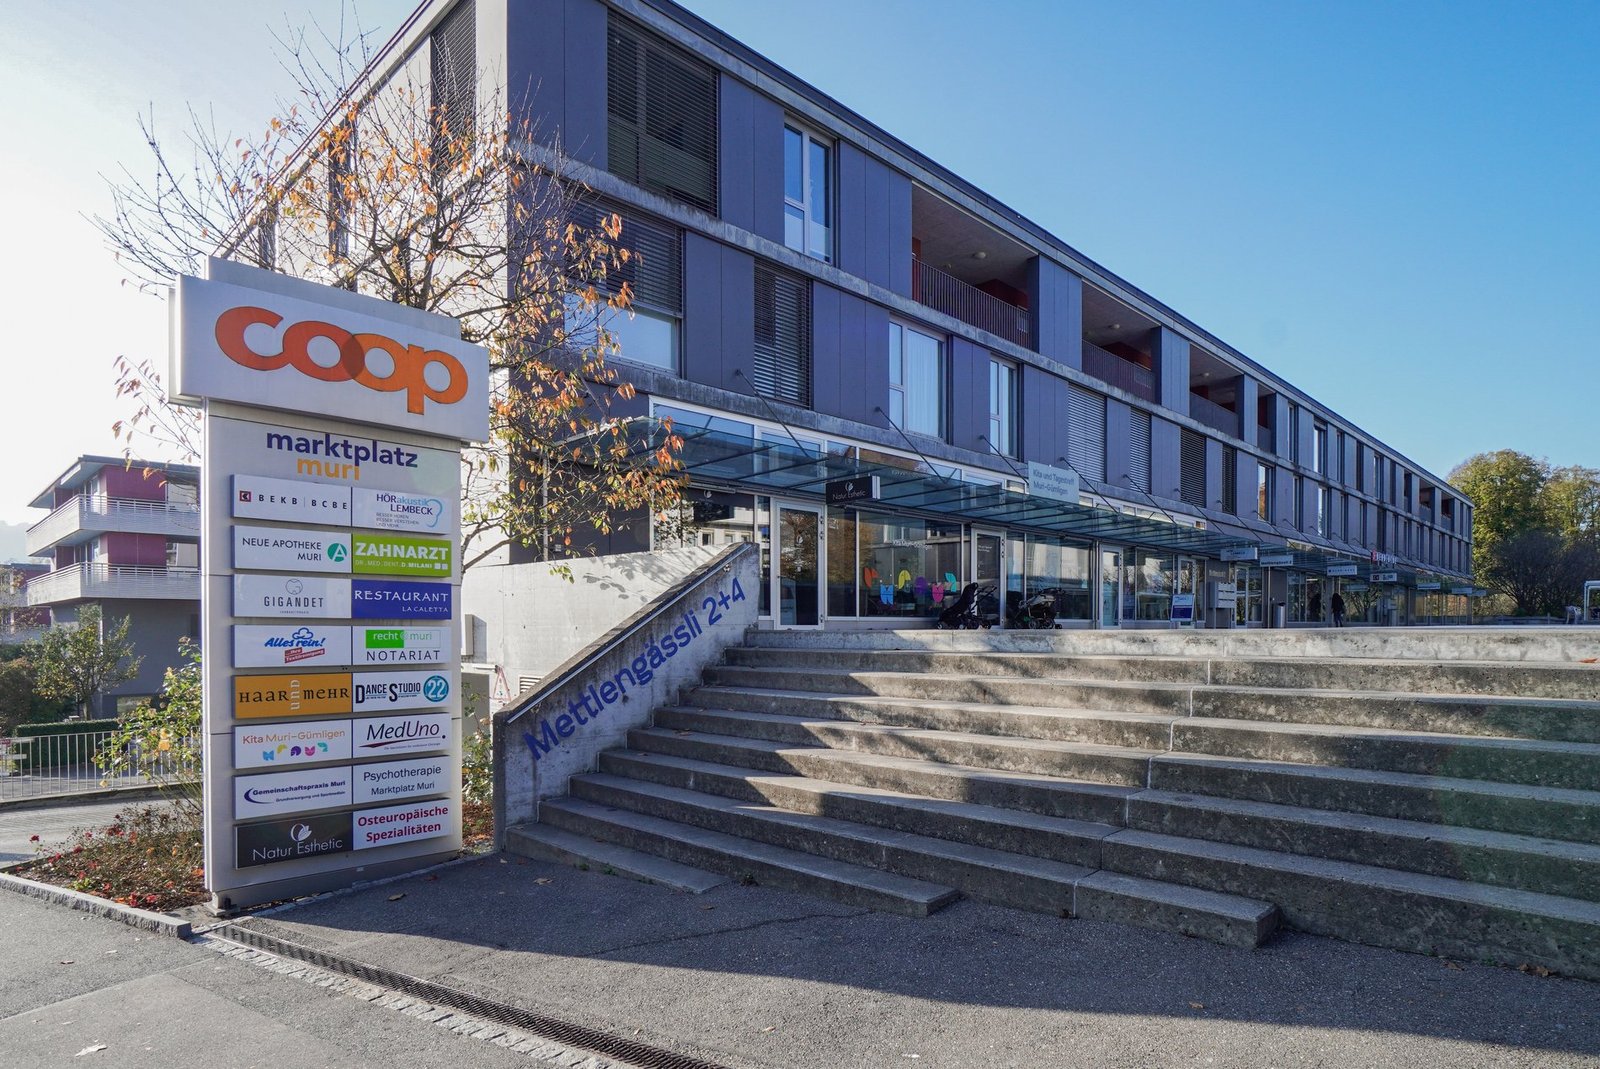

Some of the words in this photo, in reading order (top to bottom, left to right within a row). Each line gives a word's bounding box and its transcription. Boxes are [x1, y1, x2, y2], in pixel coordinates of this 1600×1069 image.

[215, 306, 469, 415] coop
[266, 432, 418, 468] marktplatz
[297, 457, 359, 481] muri
[258, 494, 297, 505] BEKB
[311, 499, 347, 509] BCBE
[390, 504, 433, 515] LEMBECK
[242, 537, 269, 547] NEUE
[272, 539, 322, 550] APOTHEKE
[355, 542, 449, 560] ZAHNARZT
[297, 552, 322, 561] MURI
[263, 596, 324, 608] GIGANDET
[354, 590, 449, 602] RESTAURANT
[264, 637, 295, 648] Alles
[295, 637, 326, 648] rein!
[373, 631, 399, 641] recht
[409, 631, 432, 641] muri
[366, 650, 441, 661] NOTARIAT
[522, 608, 703, 761] Mettlengässli
[702, 577, 746, 626] 2+4
[355, 683, 387, 704] DANCE
[388, 682, 421, 702] STUDIO
[427, 680, 447, 699] 22
[242, 734, 263, 744] Kita
[265, 728, 345, 742] Muri-Gümligen
[363, 764, 442, 782] Psychotherapie
[252, 783, 329, 796] Gemeinschaftspraxis
[371, 784, 415, 796] Marktplatz
[417, 781, 435, 791] Muri
[358, 805, 449, 827] Osteuropäische
[366, 822, 441, 843] Spezialitäten
[252, 845, 292, 861] Natur
[297, 839, 343, 854] Esthetic
